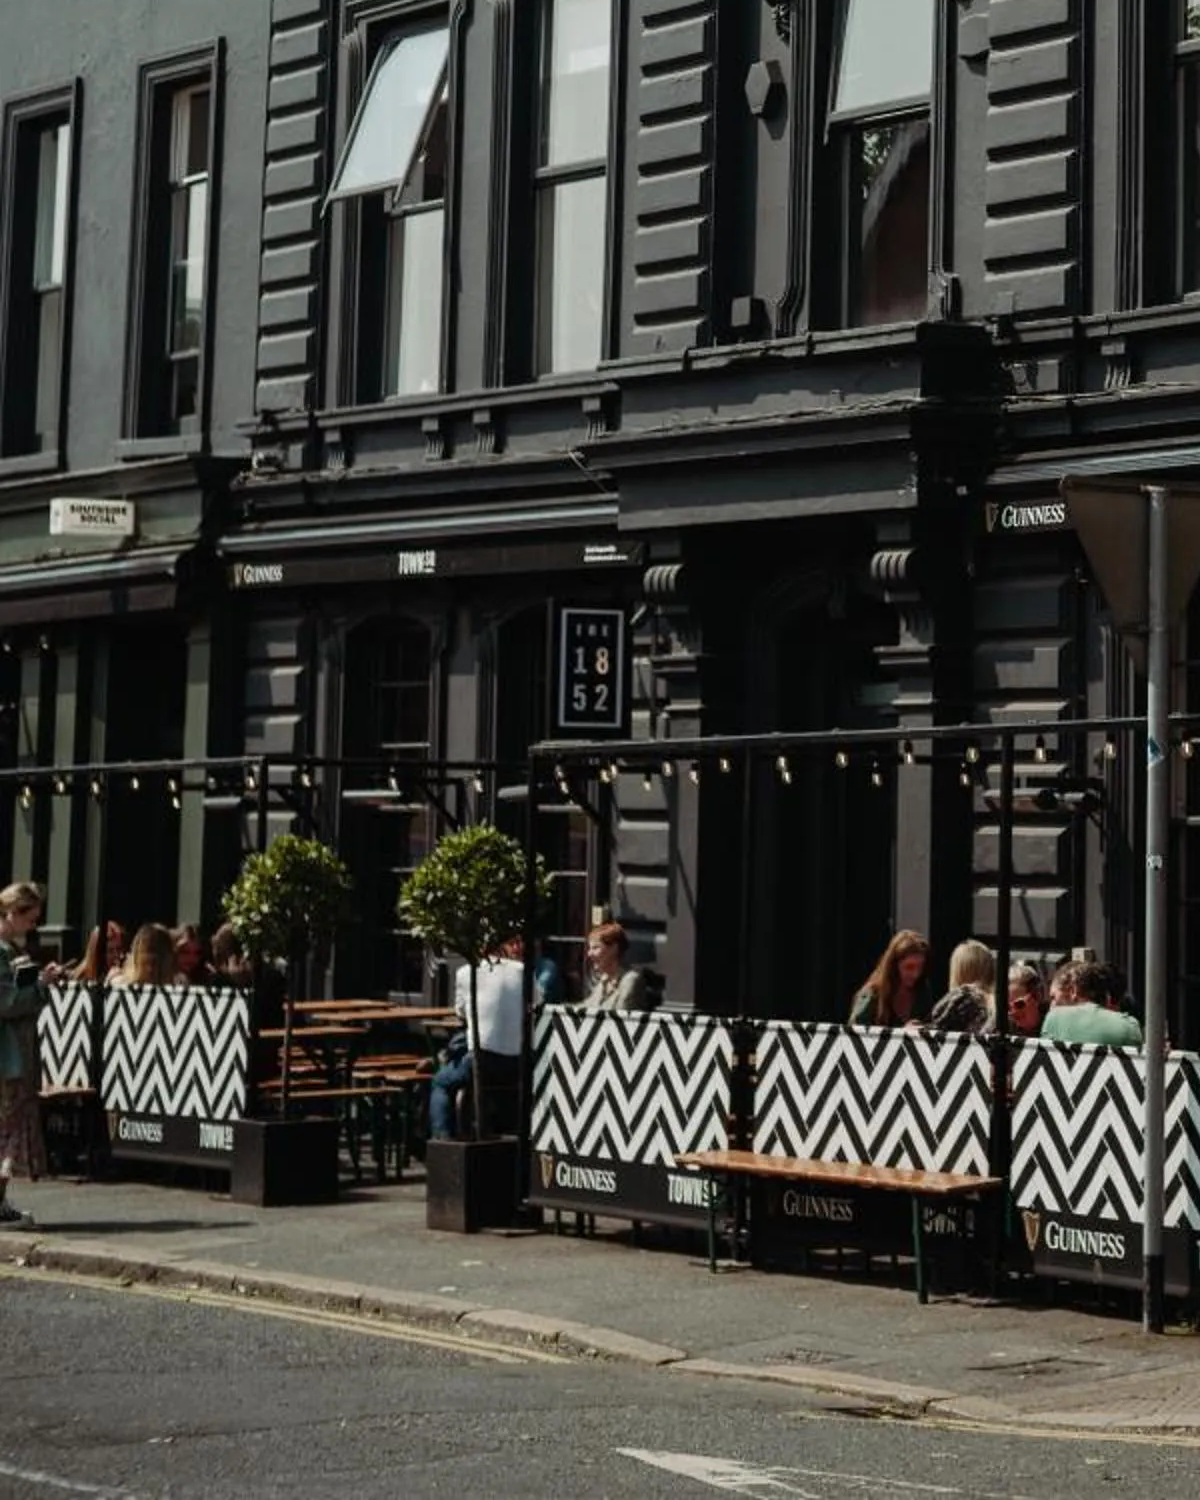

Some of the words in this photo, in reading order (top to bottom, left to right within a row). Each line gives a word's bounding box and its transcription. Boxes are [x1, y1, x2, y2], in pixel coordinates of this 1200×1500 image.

[1001, 504, 1066, 529] GUINNESS
[243, 564, 284, 585] GUINNESS
[119, 1116, 163, 1143] GUINNESS
[556, 1160, 617, 1193] GUINNESS
[783, 1189, 854, 1221] GUINNESS
[1045, 1221, 1126, 1260] GUINNESS
